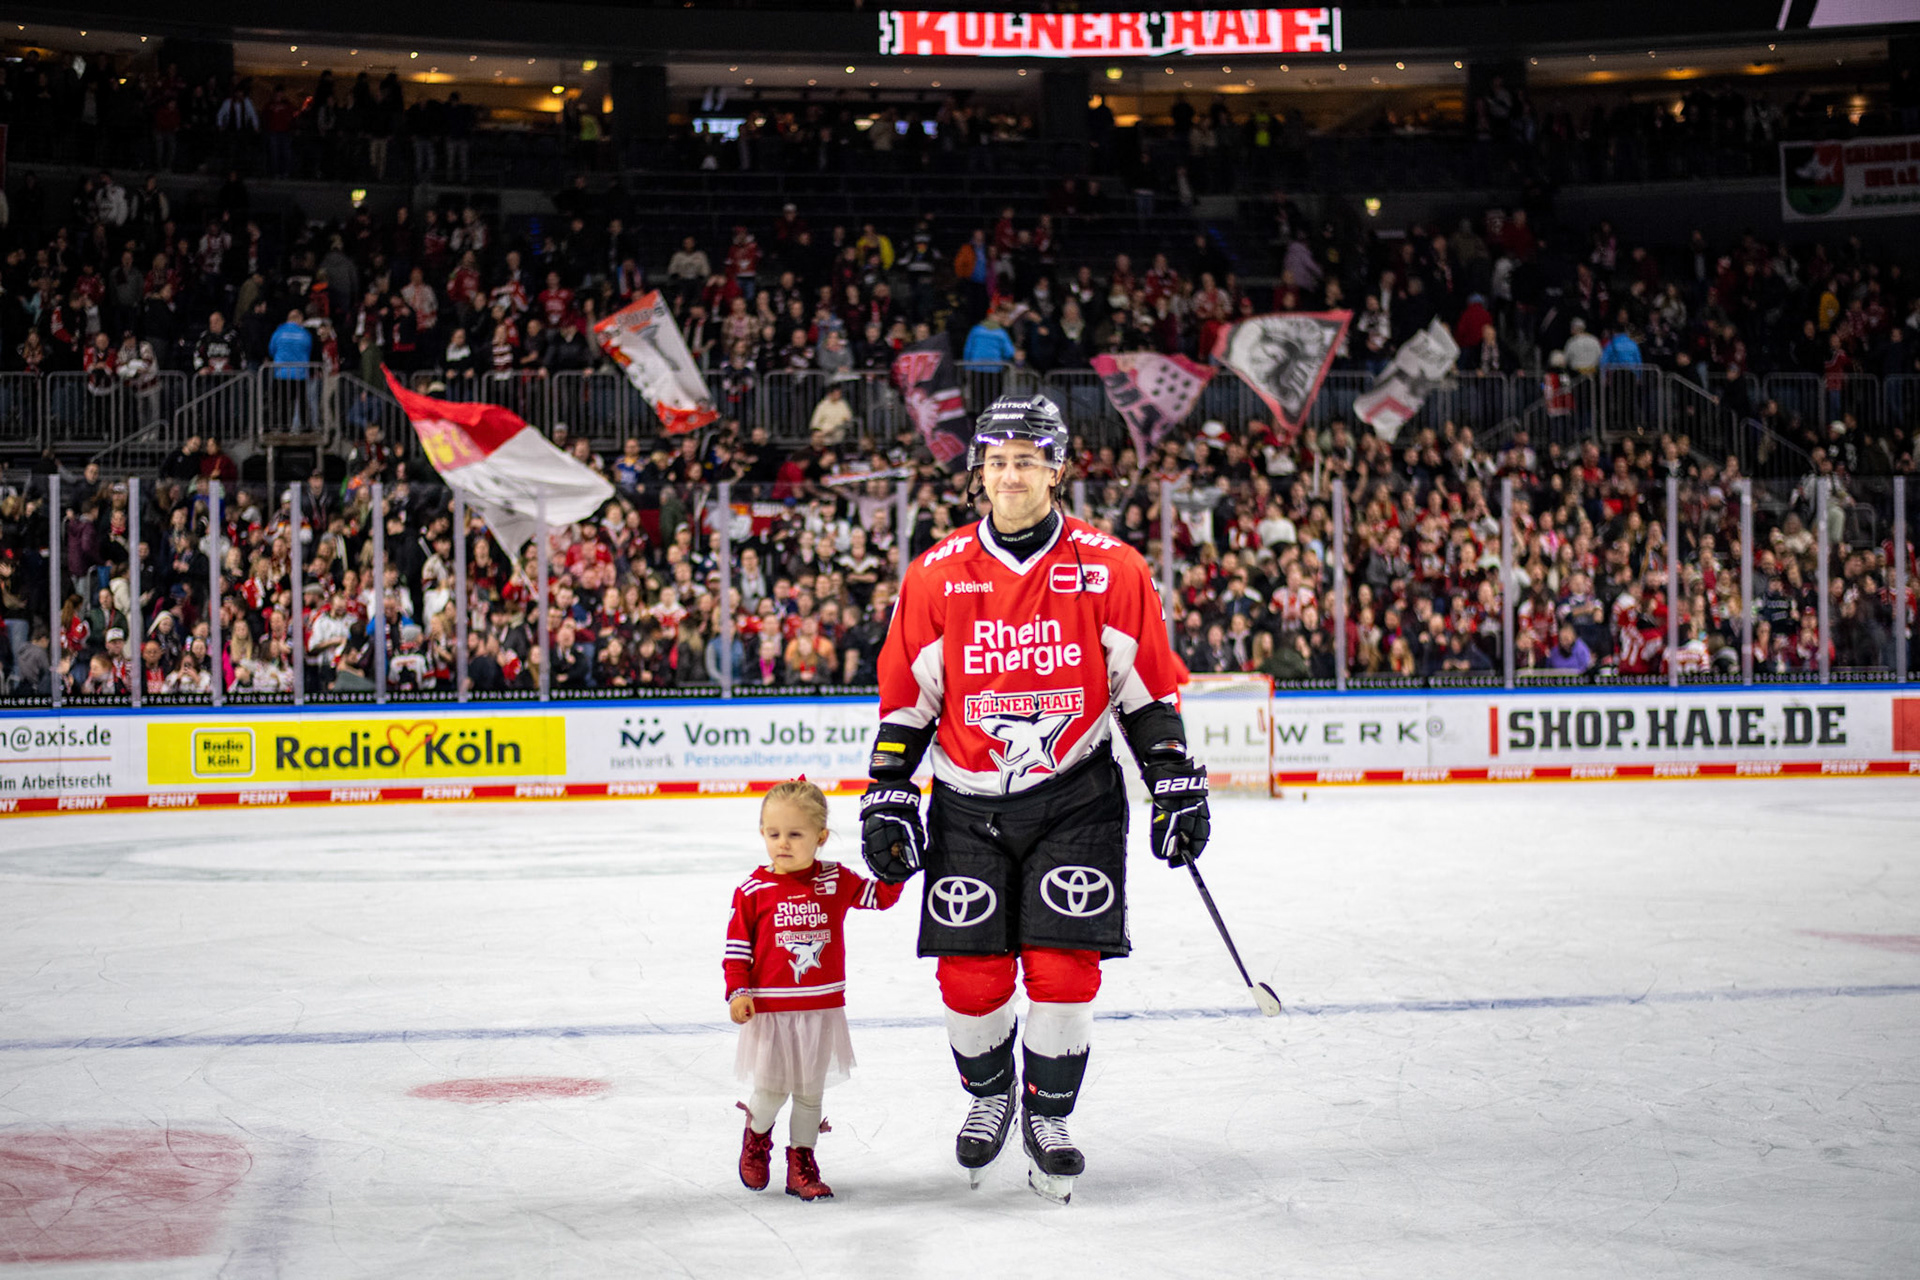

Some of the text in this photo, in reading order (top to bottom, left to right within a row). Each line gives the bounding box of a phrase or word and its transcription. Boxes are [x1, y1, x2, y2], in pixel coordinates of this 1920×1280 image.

[1171, 8, 1324, 53] HAIE
[992, 402, 1033, 410] STETSON
[953, 580, 994, 594] steinel
[974, 615, 1061, 650] Rhein
[964, 643, 1082, 676] Energie
[969, 693, 1081, 719] KÖLNER HAIE
[684, 721, 869, 746] Vom Job zur
[1508, 706, 1848, 749] SHOP.HAIE.DE
[203, 738, 243, 752] Radio
[276, 729, 521, 769] Radio Köln
[208, 755, 240, 767] Köln
[684, 748, 863, 769] Personalberatung auf
[22, 771, 112, 790] Arbeitsrecht
[607, 781, 658, 795] PENNY
[698, 779, 749, 793] PENNY
[239, 791, 289, 805] PENNY
[330, 788, 380, 803] PENNY
[422, 785, 473, 800] PENNY
[515, 783, 566, 798] PENNY
[58, 795, 106, 810] PENNY
[148, 794, 197, 808] PENNY
[861, 790, 920, 810] AUER
[777, 900, 821, 916] Rhein
[774, 911, 828, 928] Energie
